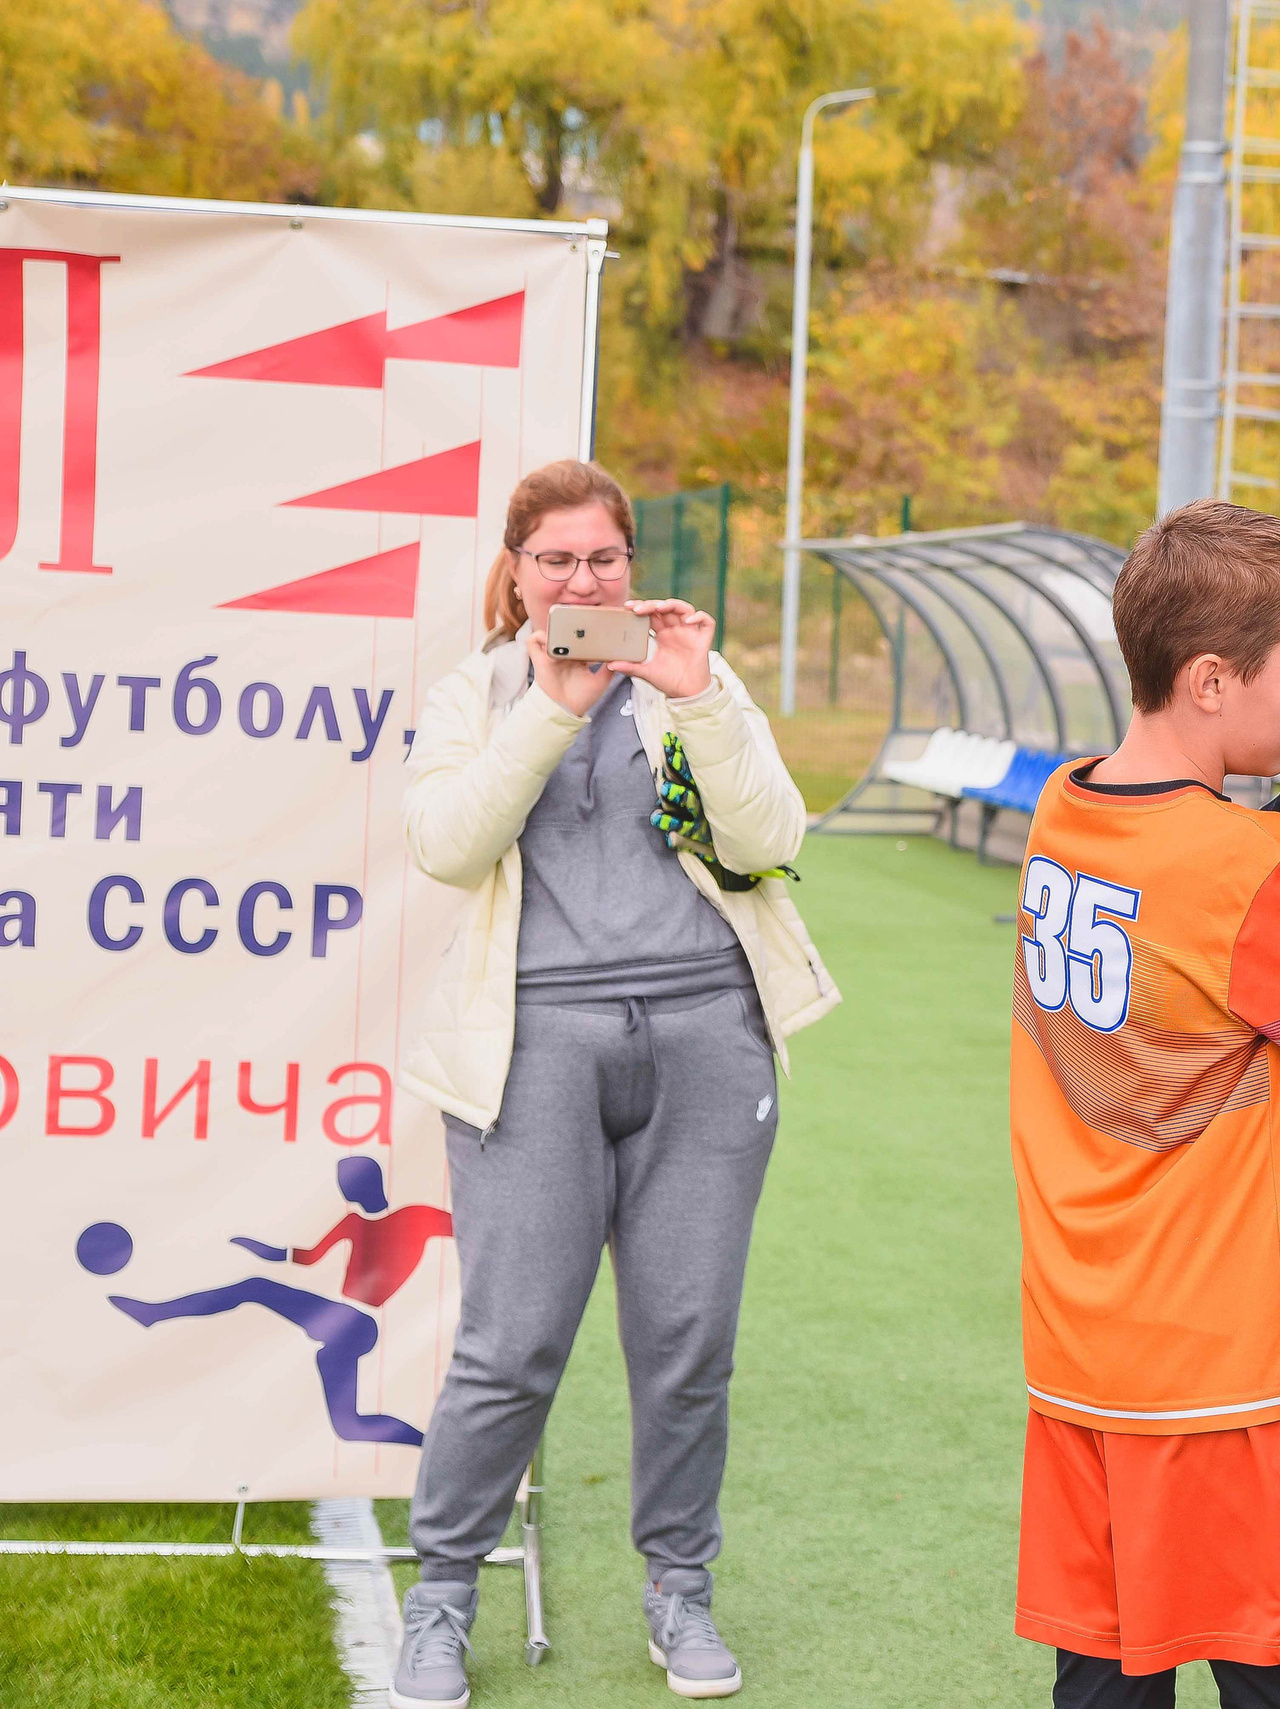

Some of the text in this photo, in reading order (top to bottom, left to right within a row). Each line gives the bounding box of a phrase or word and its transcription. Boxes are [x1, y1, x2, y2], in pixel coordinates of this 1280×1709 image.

[88, 875, 364, 958] СССР
[1021, 854, 1143, 1034] 35
[0, 1053, 393, 1147] вича
